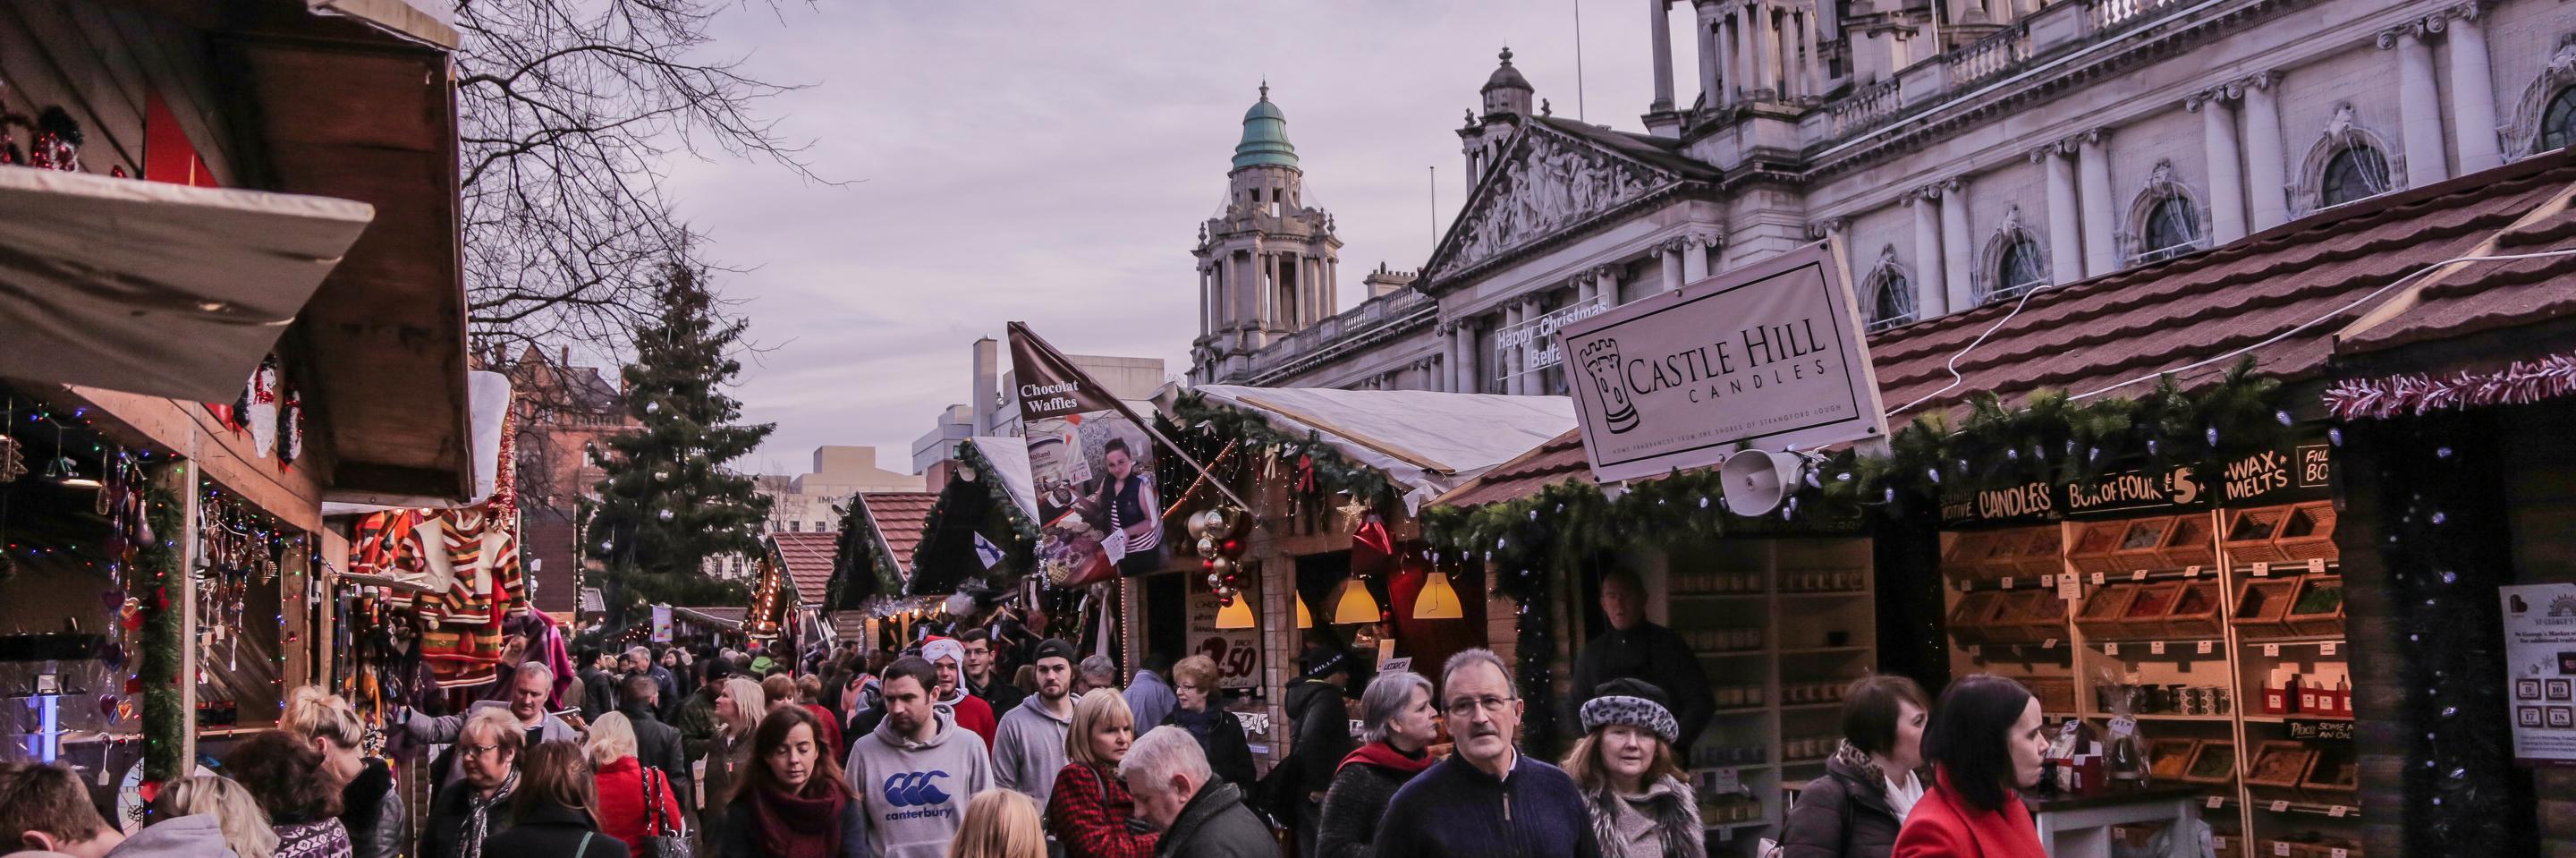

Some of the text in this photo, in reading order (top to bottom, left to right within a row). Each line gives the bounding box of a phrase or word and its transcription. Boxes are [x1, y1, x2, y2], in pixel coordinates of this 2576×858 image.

[1497, 301, 1609, 350] Happy Christmas
[1531, 343, 1562, 368] Belfa
[1627, 319, 1826, 395] CASTLE HILL
[1021, 380, 1080, 397] Chocolat
[1689, 360, 1825, 403] CANDLES
[1028, 397, 1078, 413] Waffles
[1678, 434, 1695, 442] FROM
[1760, 411, 1809, 427] STRANGFORD
[1814, 404, 1842, 415] LOUGH
[2228, 450, 2277, 480] WAX
[2306, 463, 2328, 482] BO
[2102, 482, 2117, 502] OF
[2226, 469, 2288, 500] MELTS
[1979, 482, 2052, 519] CANDLES
[2552, 686, 2563, 694] 10
[2525, 712, 2535, 721] 17
[2291, 721, 2317, 737] Place
[2318, 721, 2346, 731] SOME
[886, 807, 953, 820] canterbury
